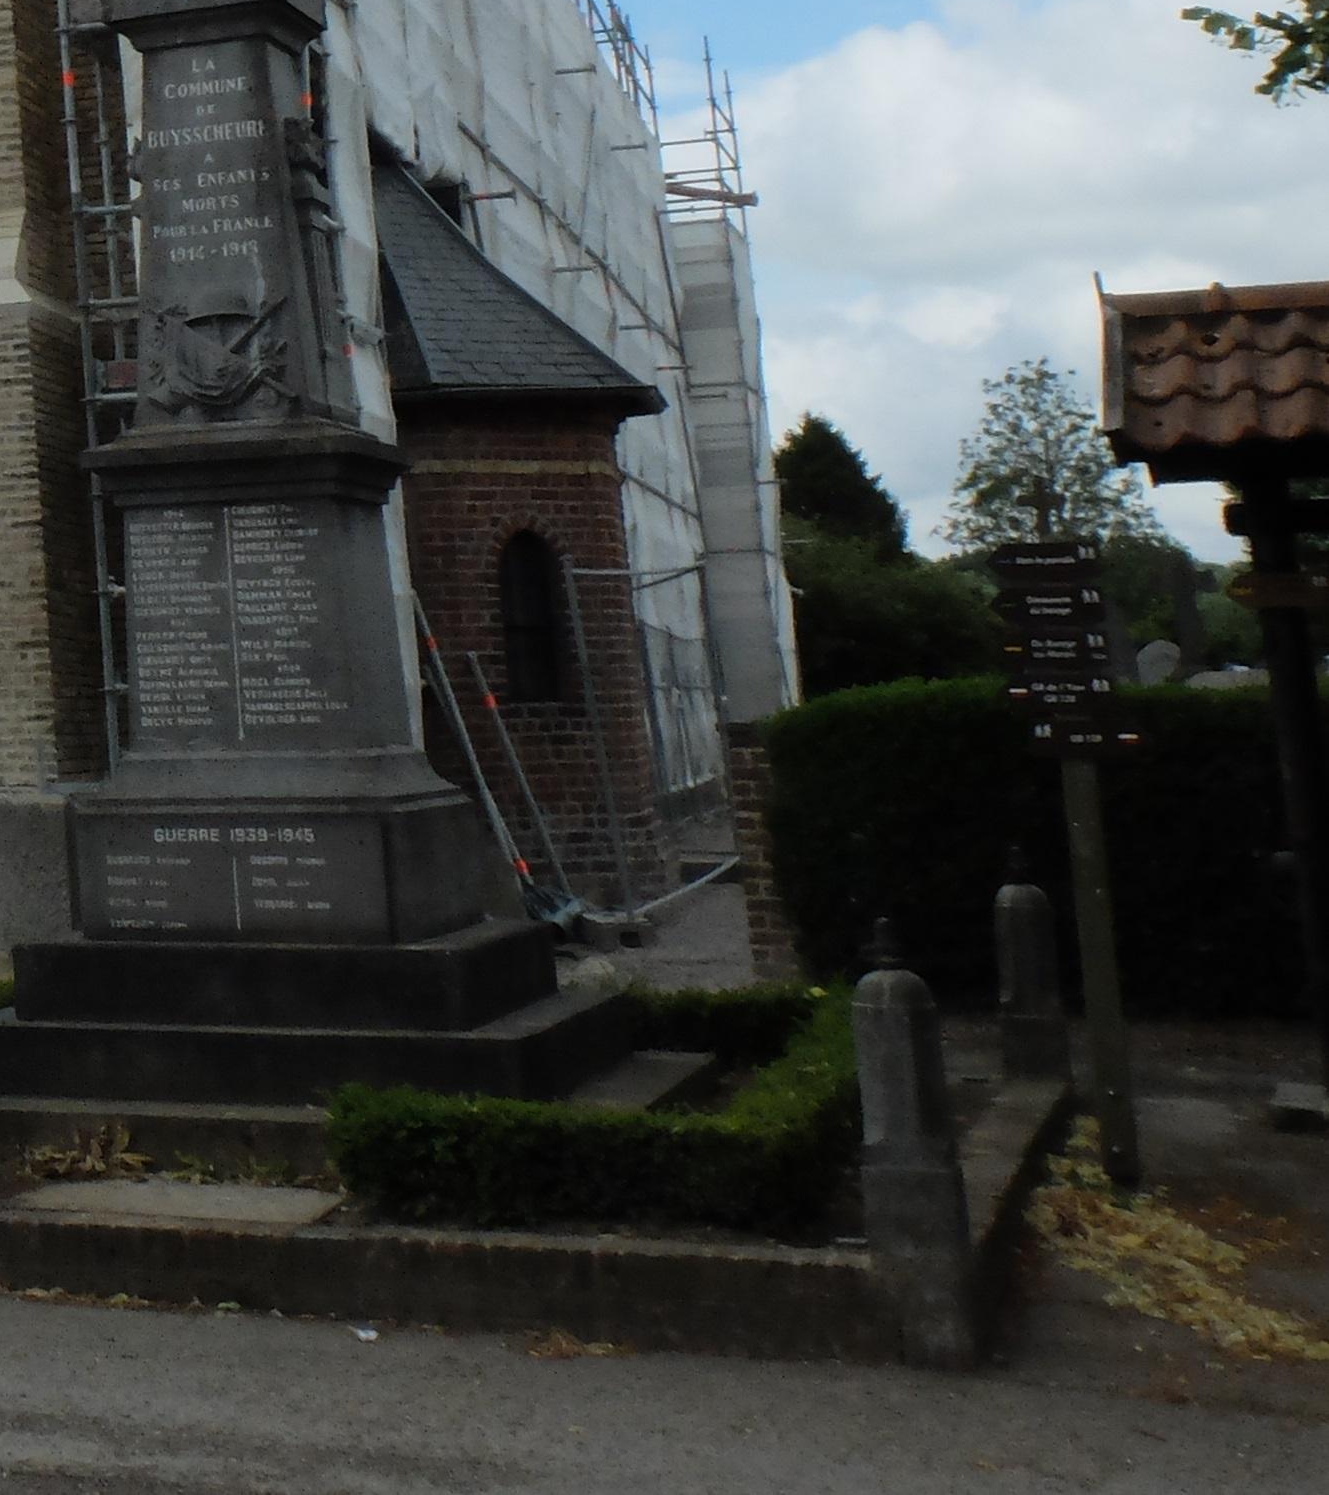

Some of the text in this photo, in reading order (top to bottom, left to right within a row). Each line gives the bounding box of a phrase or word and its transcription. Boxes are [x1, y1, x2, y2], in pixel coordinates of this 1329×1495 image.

[191, 57, 216, 74] LA
[164, 75, 249, 100] COMMUNE
[196, 103, 217, 115] DE
[152, 167, 271, 192] SES ENFANTS
[181, 194, 240, 213] MORTS
[212, 215, 274, 235] FRANCE
[153, 826, 316, 844] GUERRE 1939-1945
